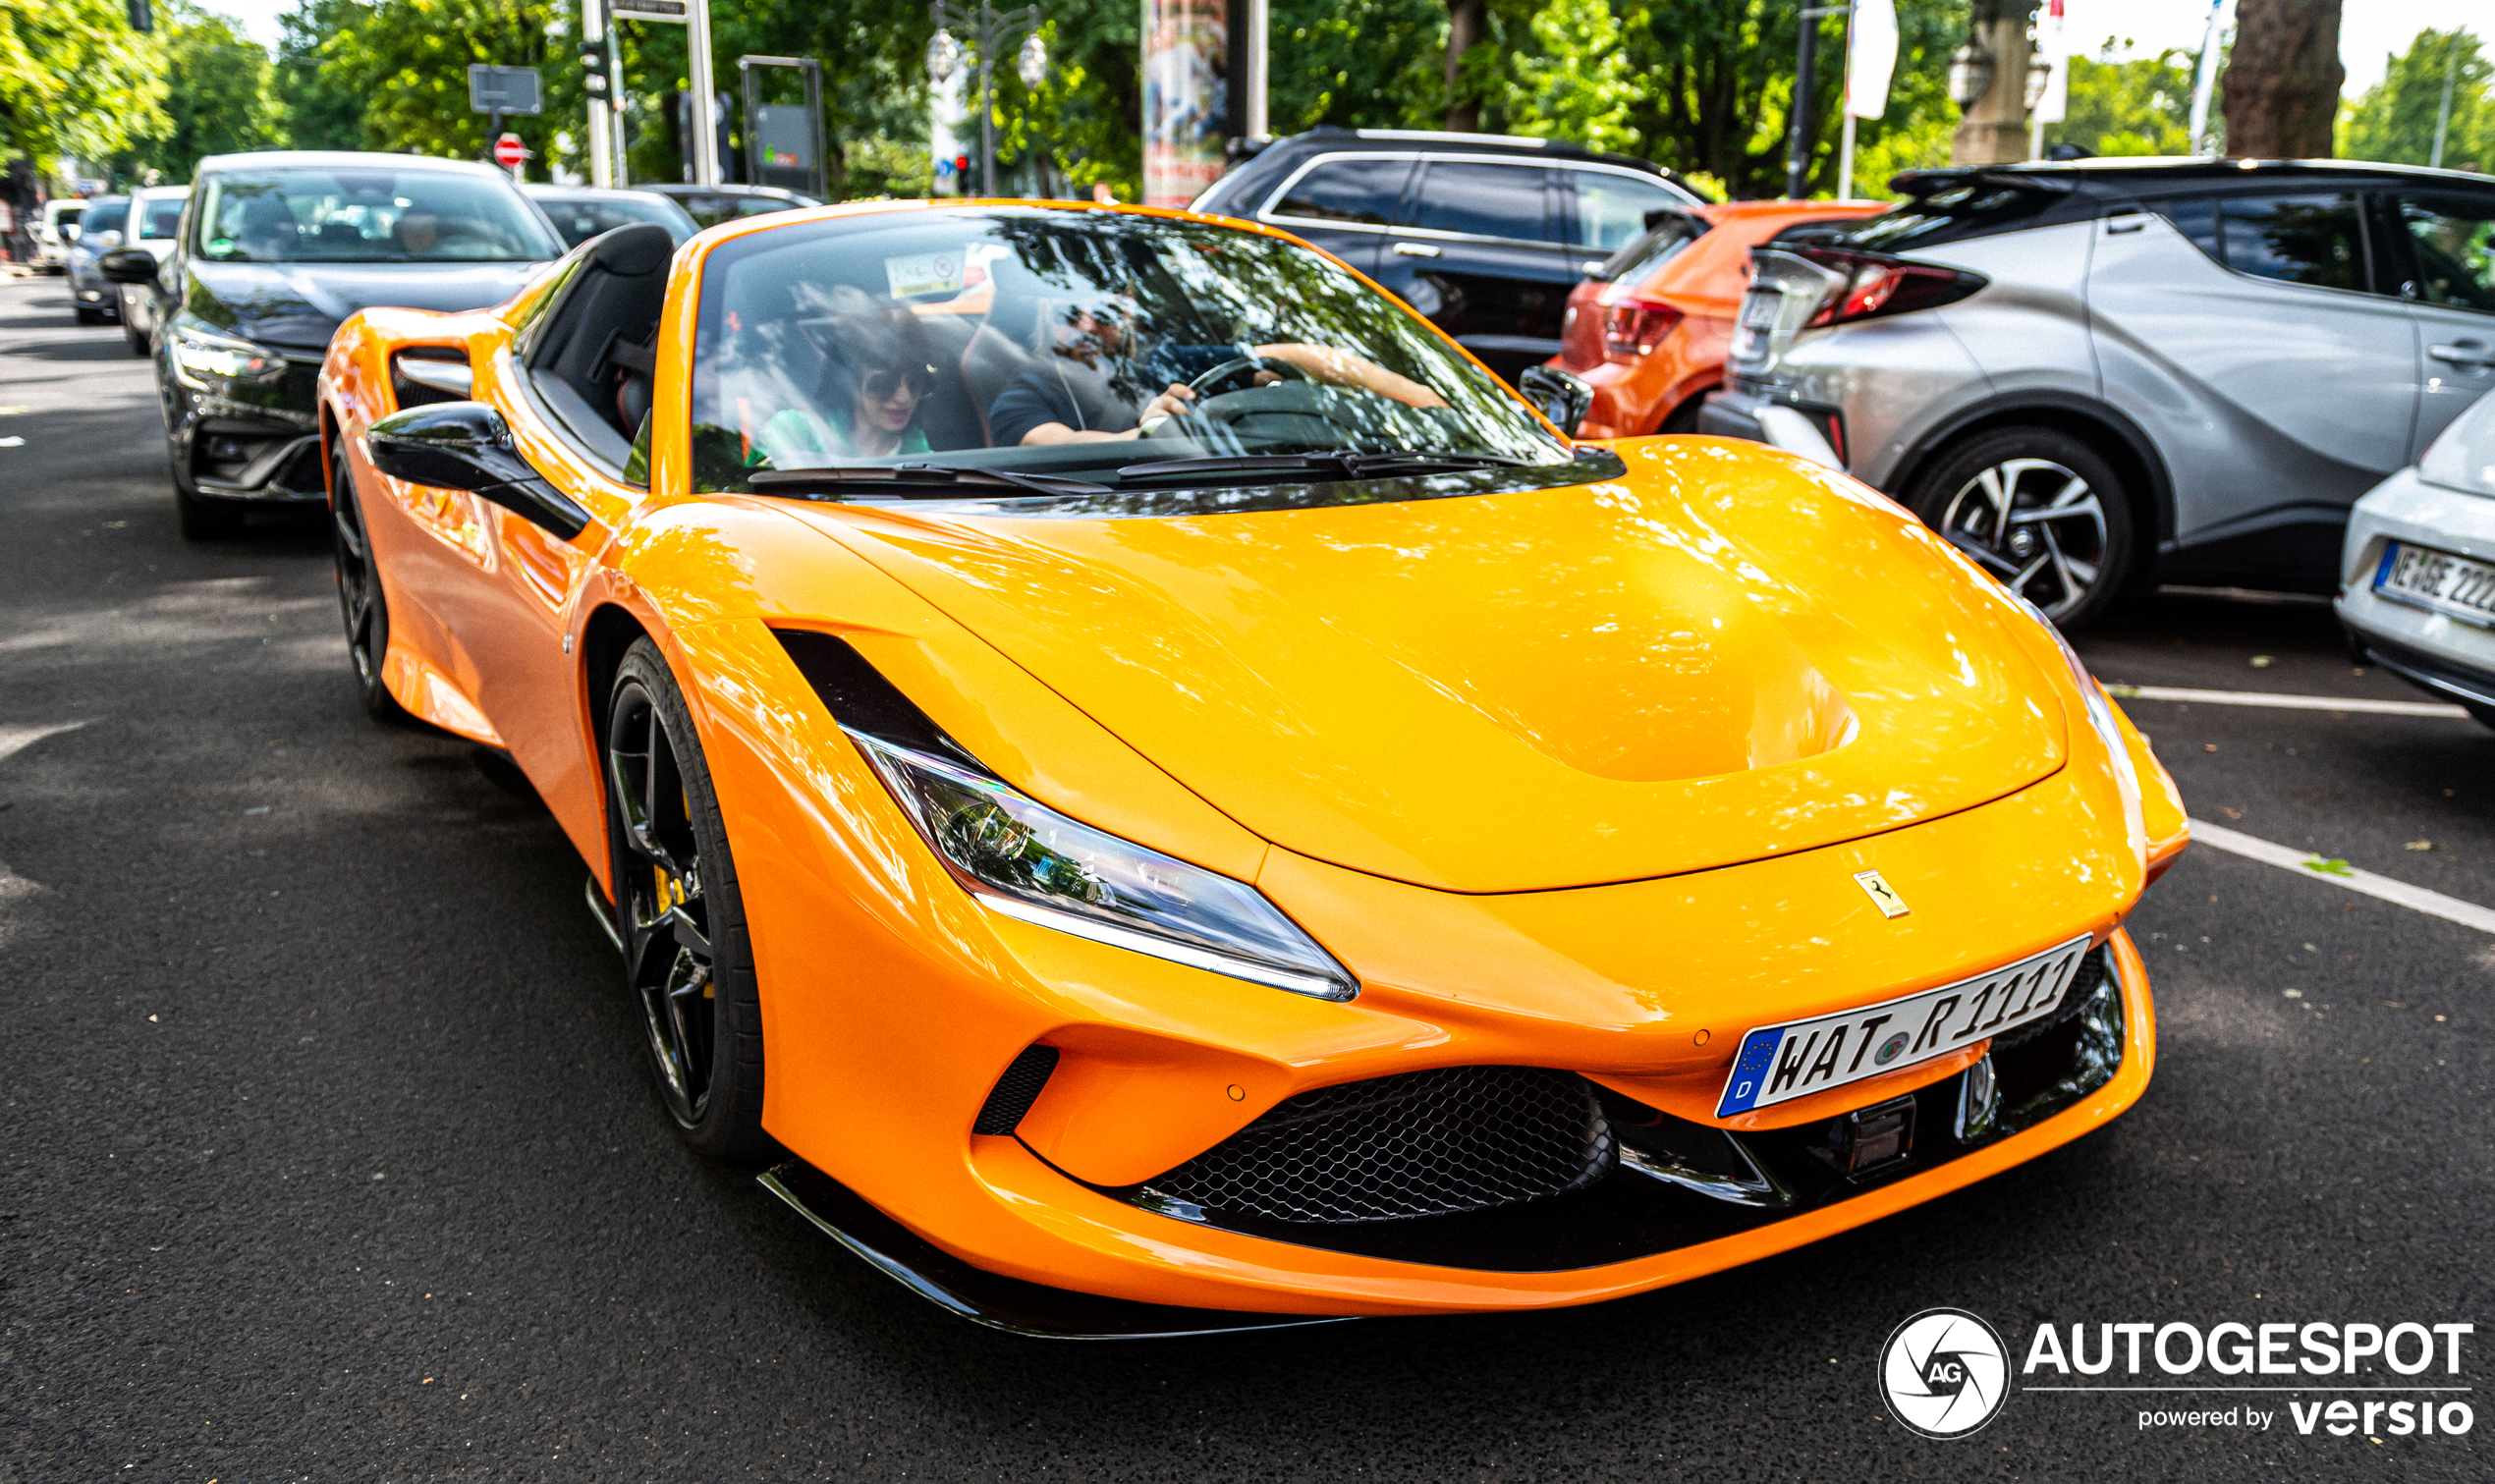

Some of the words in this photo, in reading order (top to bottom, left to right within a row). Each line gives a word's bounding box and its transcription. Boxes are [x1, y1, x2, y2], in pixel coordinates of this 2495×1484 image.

[2449, 566, 2495, 612] 222
[1767, 1013, 1893, 1095] WAT
[1735, 1081, 1751, 1099] D
